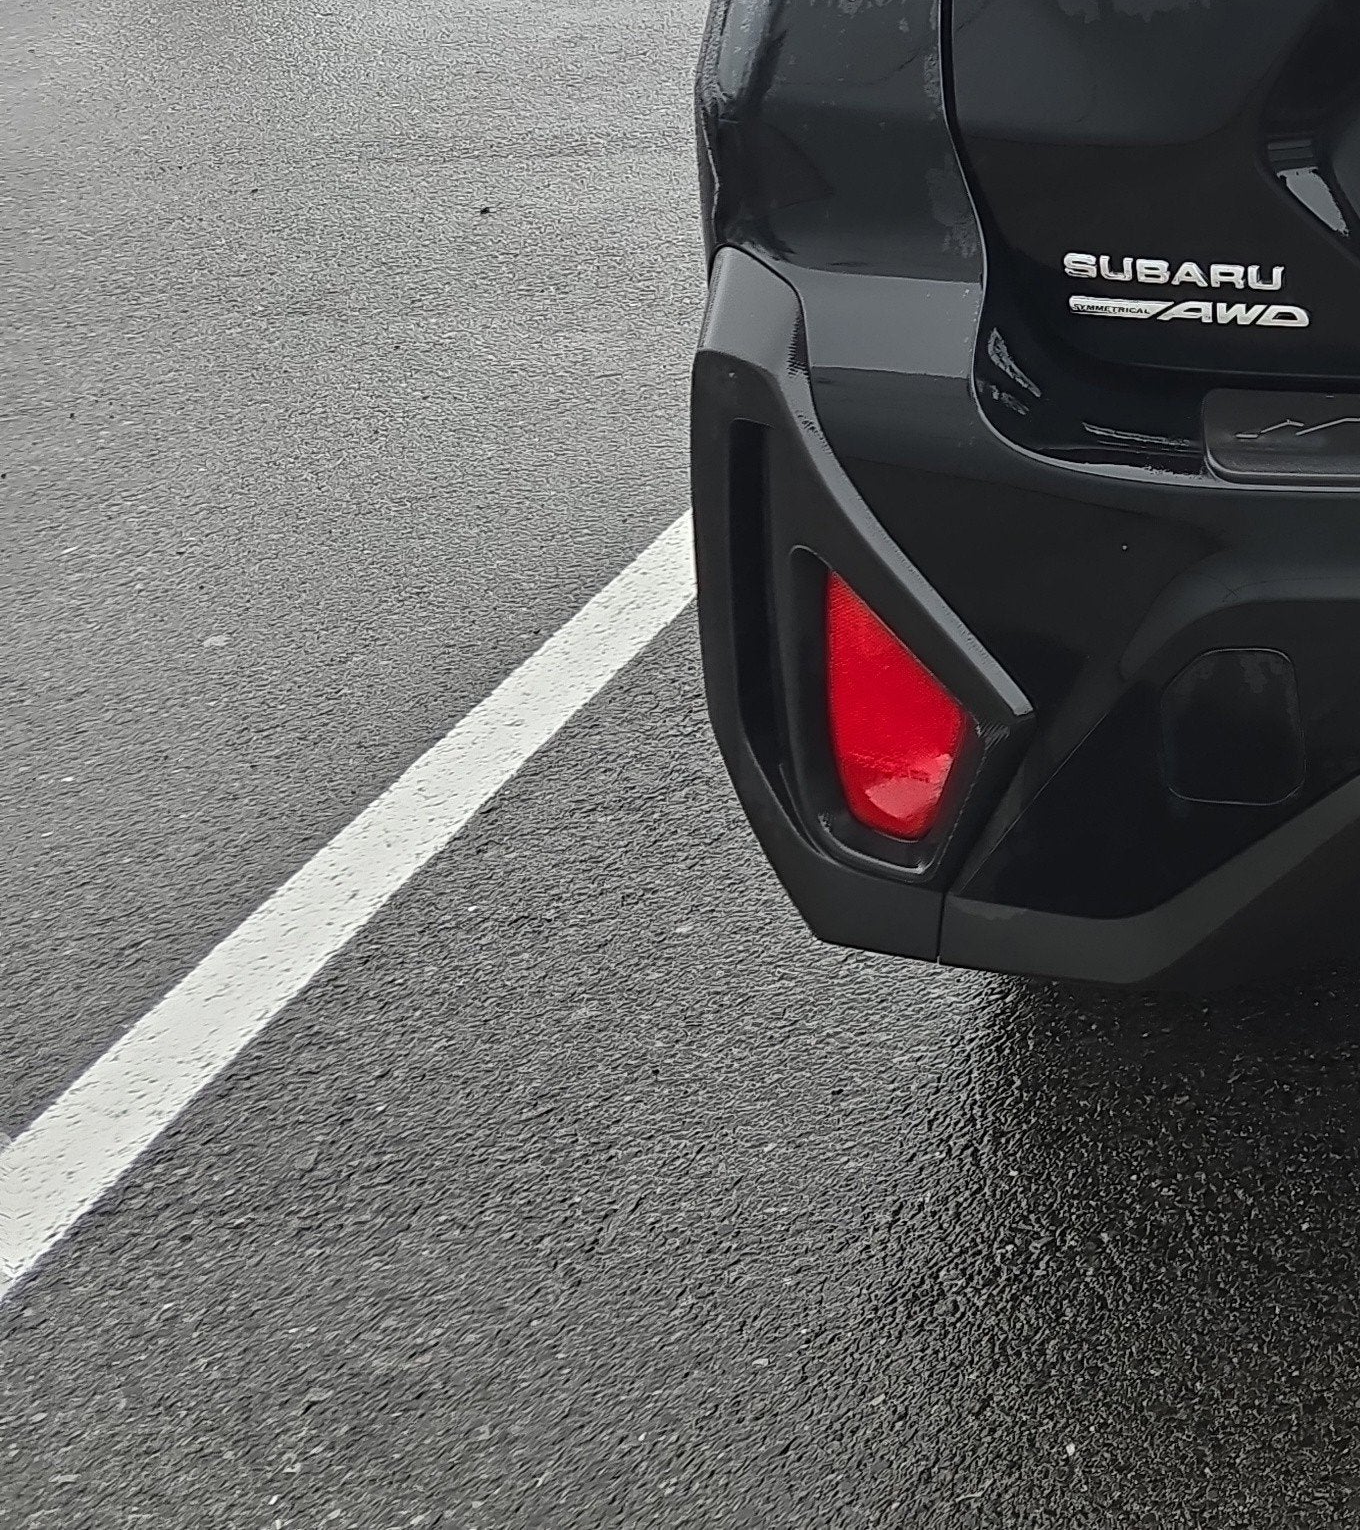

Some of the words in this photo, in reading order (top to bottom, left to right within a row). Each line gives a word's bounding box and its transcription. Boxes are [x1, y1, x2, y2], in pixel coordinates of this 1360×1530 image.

[1063, 252, 1285, 291] SUBARU
[1073, 303, 1151, 315] SYMMETRICAL
[1156, 301, 1310, 328] AWD
